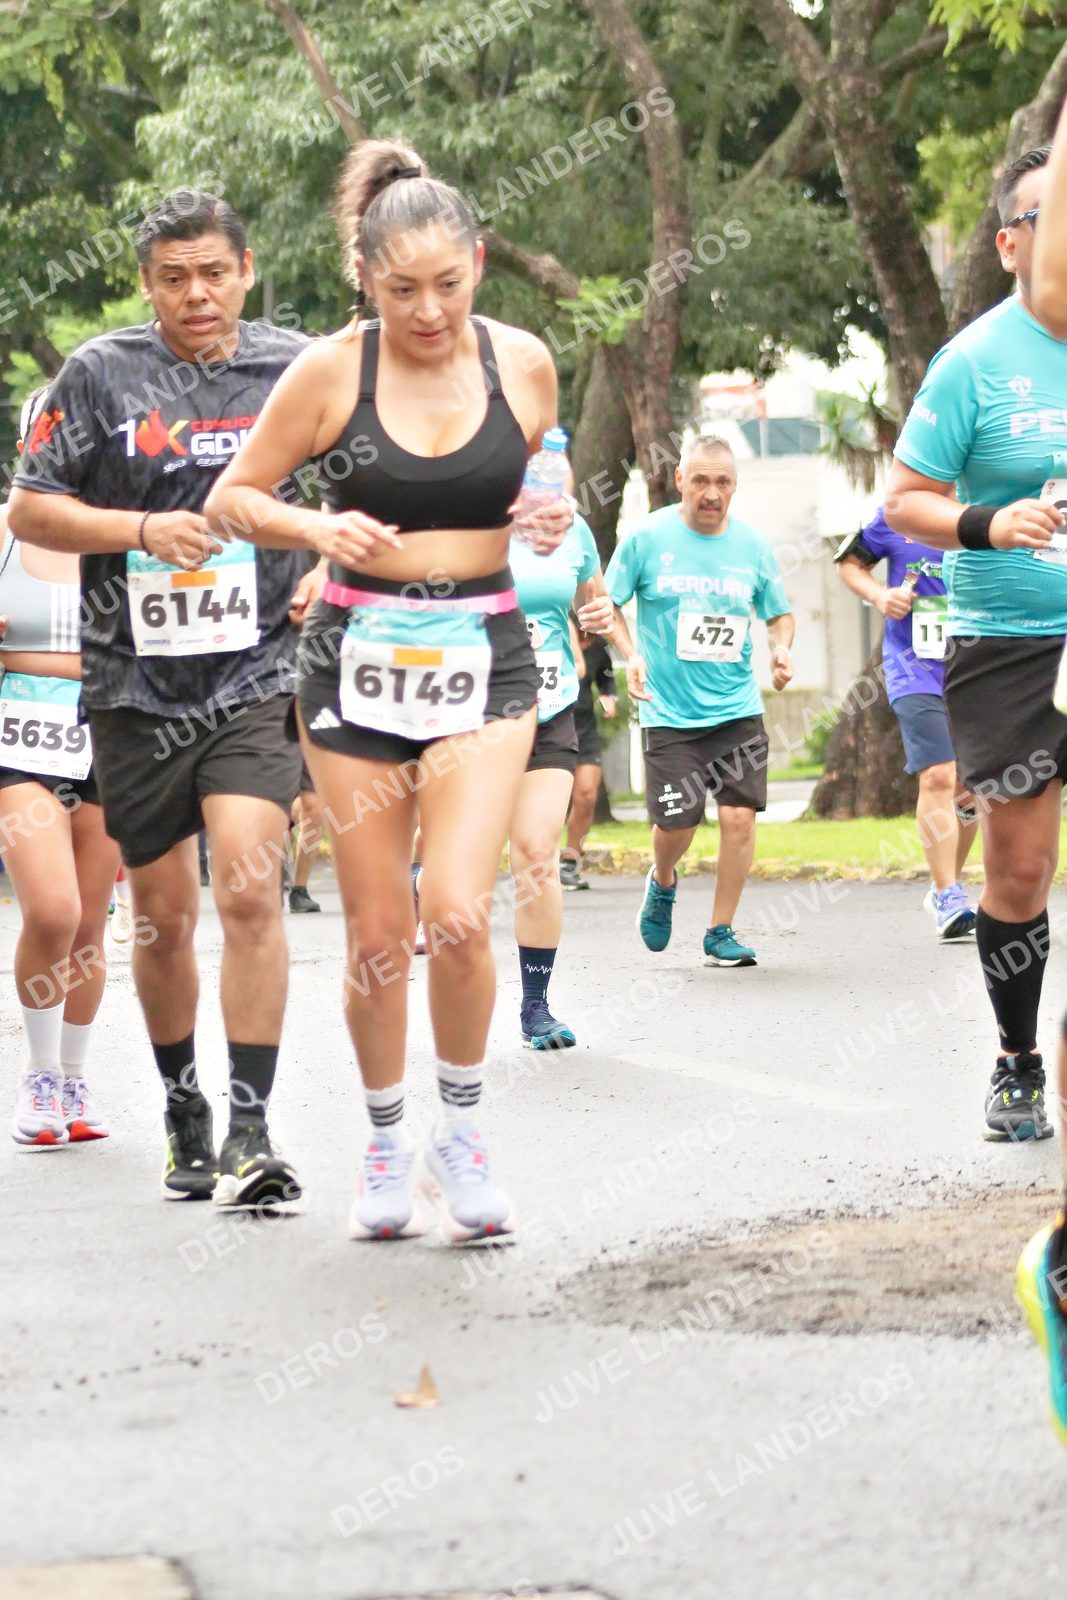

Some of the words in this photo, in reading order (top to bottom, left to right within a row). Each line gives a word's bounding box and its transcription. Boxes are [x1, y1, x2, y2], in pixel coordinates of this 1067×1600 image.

[1009, 409, 1067, 437] PE
[141, 587, 250, 628] 6144
[691, 626, 735, 647] 472
[354, 663, 475, 706] 6149
[0, 717, 87, 754] 5639
[658, 791, 683, 803] adidas
